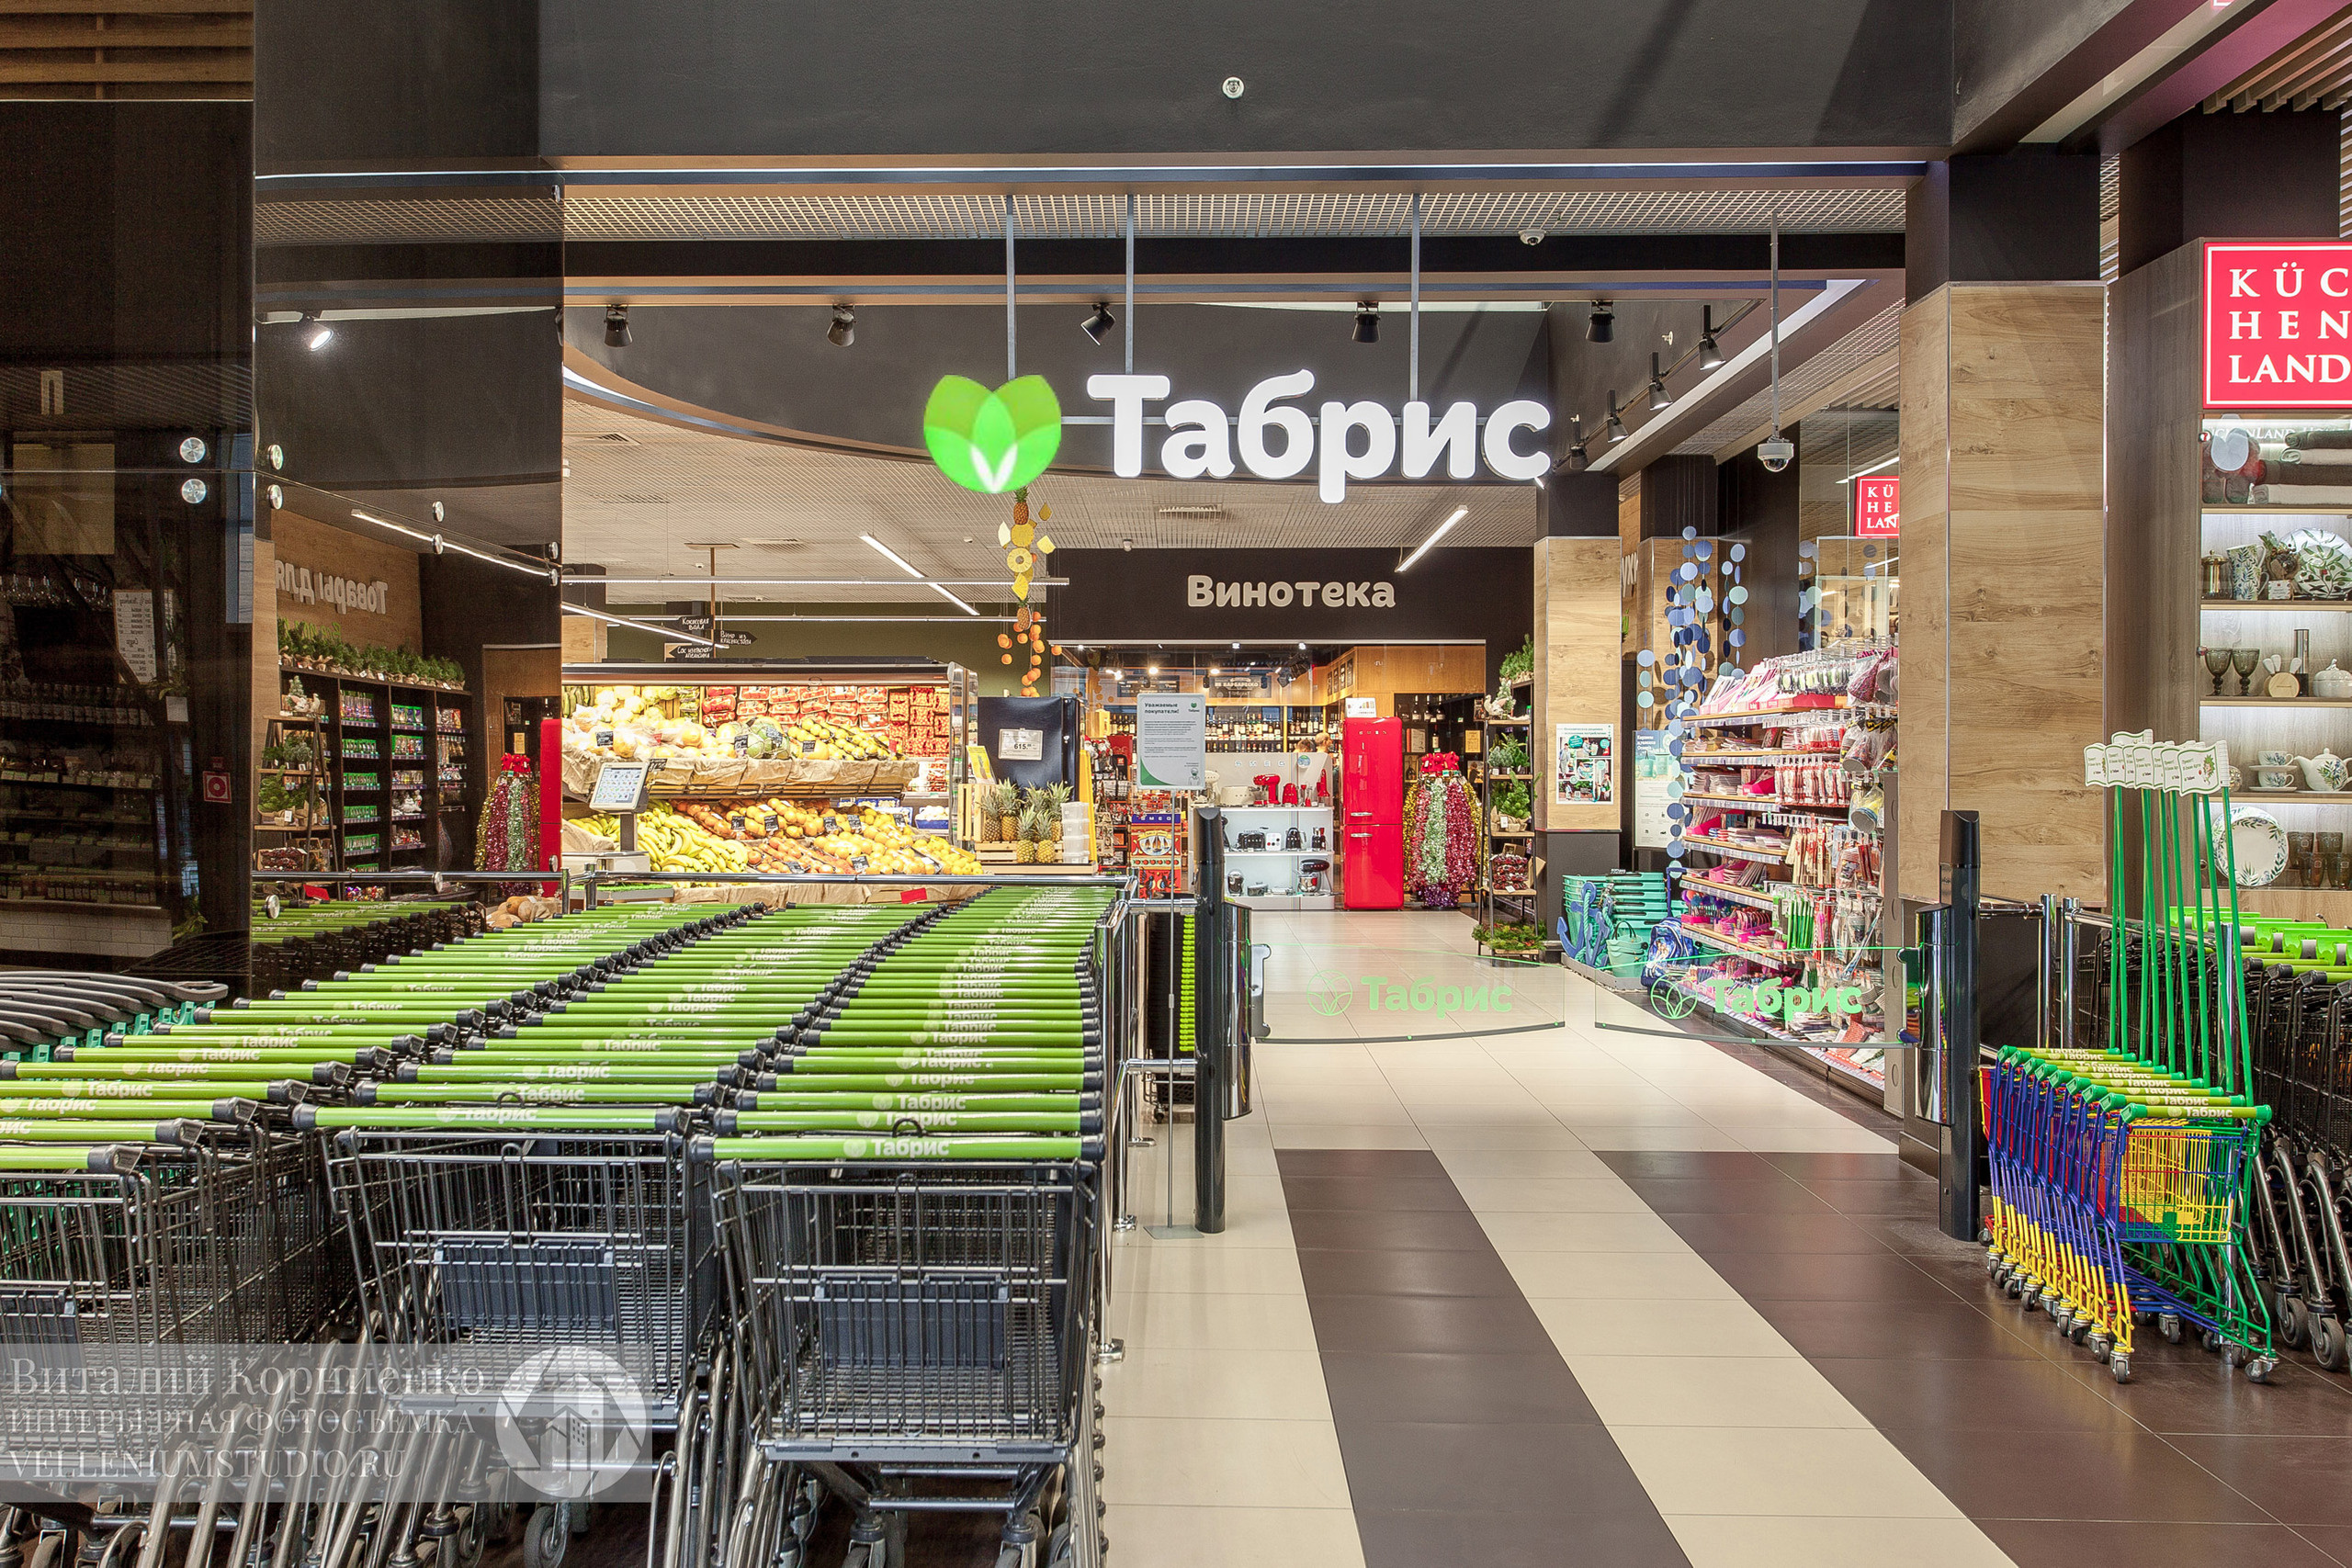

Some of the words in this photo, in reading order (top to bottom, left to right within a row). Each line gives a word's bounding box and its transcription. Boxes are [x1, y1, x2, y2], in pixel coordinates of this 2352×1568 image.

[2229, 262, 2349, 298] KÜC
[2229, 310, 2351, 339] HEN
[2229, 355, 2351, 383] LAND
[1087, 369, 1552, 504] Табрис
[1867, 484, 1894, 498] KÜ
[1867, 502, 1893, 513] HE
[1866, 517, 1898, 529] LAN
[1187, 575, 1396, 608] Винотека
[1361, 975, 1513, 1020] Табрис
[1706, 976, 1863, 1021] Табрис
[200, 1047, 261, 1062] Табрис
[86, 1081, 154, 1098] Табрис
[516, 1086, 585, 1101] Табрис
[896, 1094, 967, 1111] Табрис
[2164, 1096, 2210, 1106] Табрис
[2184, 1107, 2233, 1119] Табрис
[871, 1138, 950, 1157] Табрис
